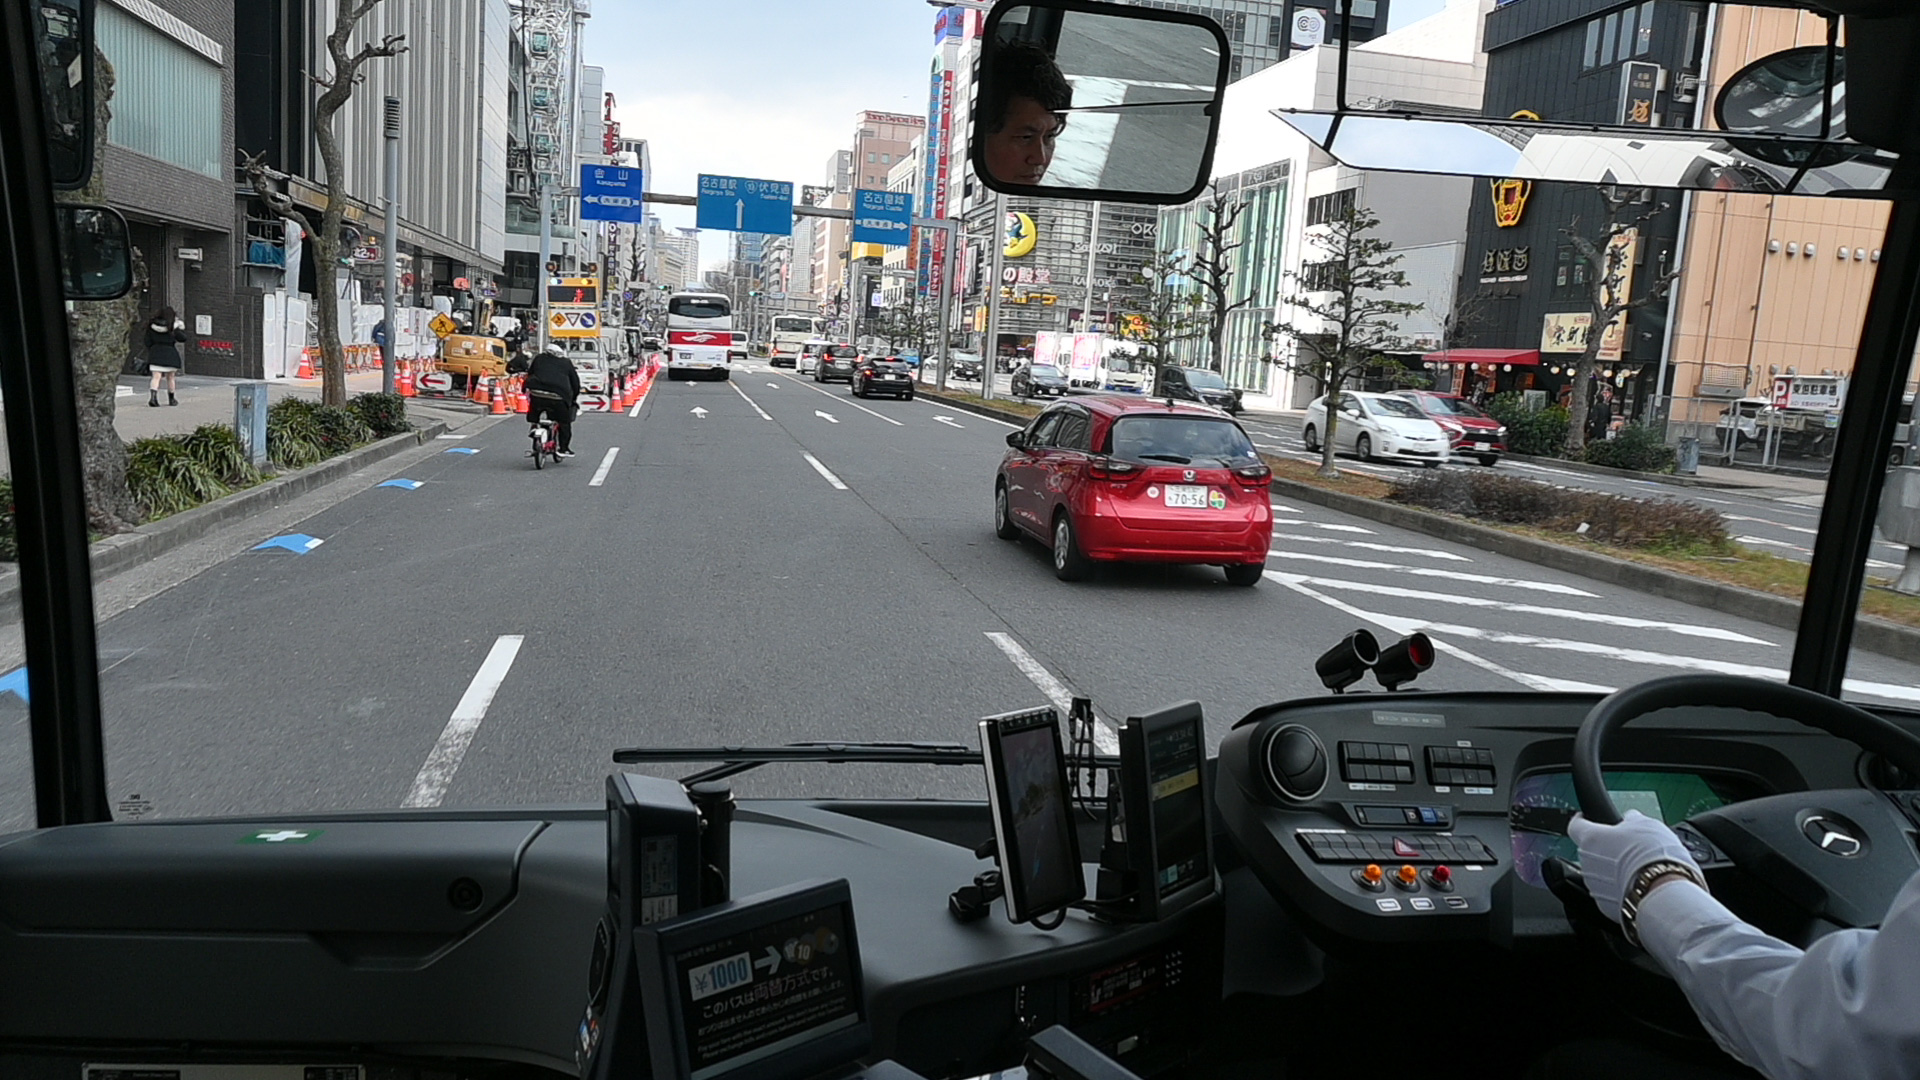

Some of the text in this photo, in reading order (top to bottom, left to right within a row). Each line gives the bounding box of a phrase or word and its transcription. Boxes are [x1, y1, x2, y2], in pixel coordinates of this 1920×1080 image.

[594, 168, 628, 180] 金山
[701, 177, 738, 190] 名古屋駅
[759, 182, 790, 195] 伏見通
[1174, 494, 1204, 506] 70-56
[702, 966, 834, 1019] このバスは両替方式です。
